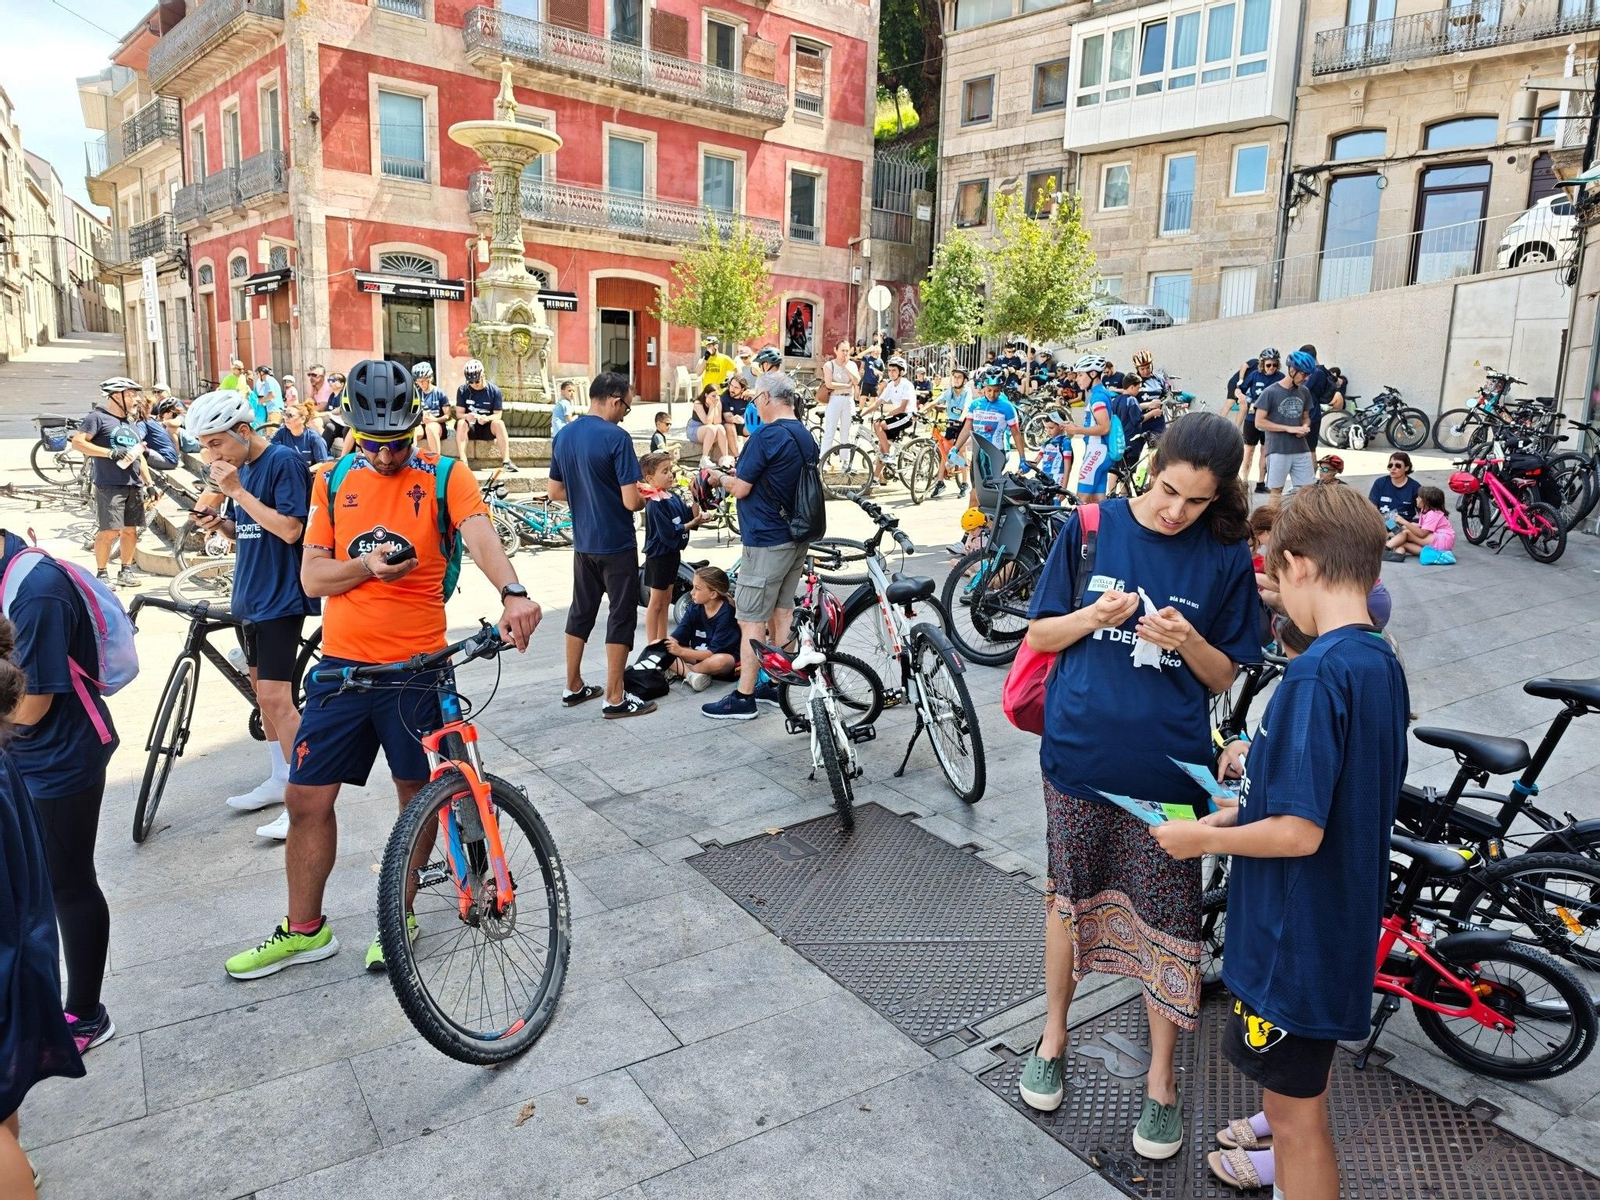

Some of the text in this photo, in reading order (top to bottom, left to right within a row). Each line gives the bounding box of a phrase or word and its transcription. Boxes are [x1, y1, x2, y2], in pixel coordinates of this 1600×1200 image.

[429, 288, 460, 298] HIROKI
[546, 299, 573, 308] HIROKI
[548, 856, 568, 918] MAXXIS
